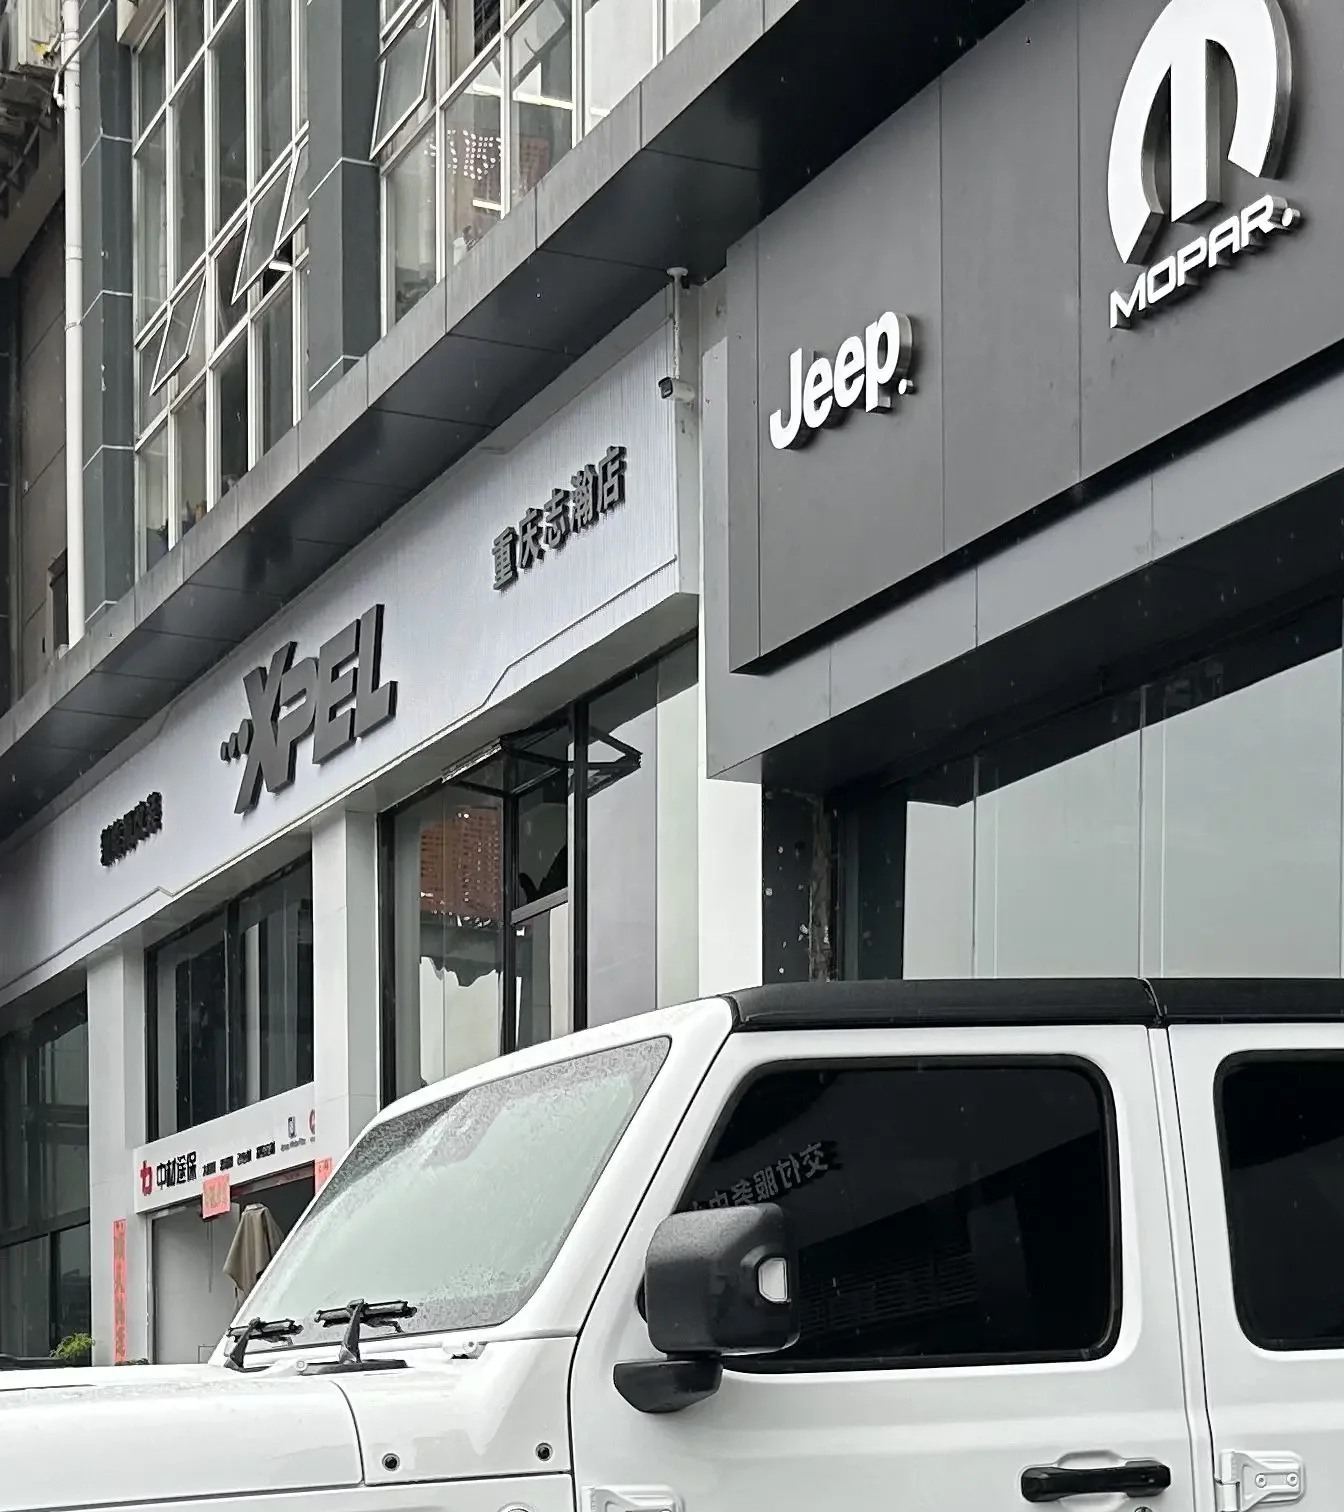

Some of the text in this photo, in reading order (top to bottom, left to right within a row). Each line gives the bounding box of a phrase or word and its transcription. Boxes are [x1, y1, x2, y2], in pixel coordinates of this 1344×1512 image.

[492, 446, 627, 591] 重庆志瀚店
[233, 604, 399, 815] XPEL
